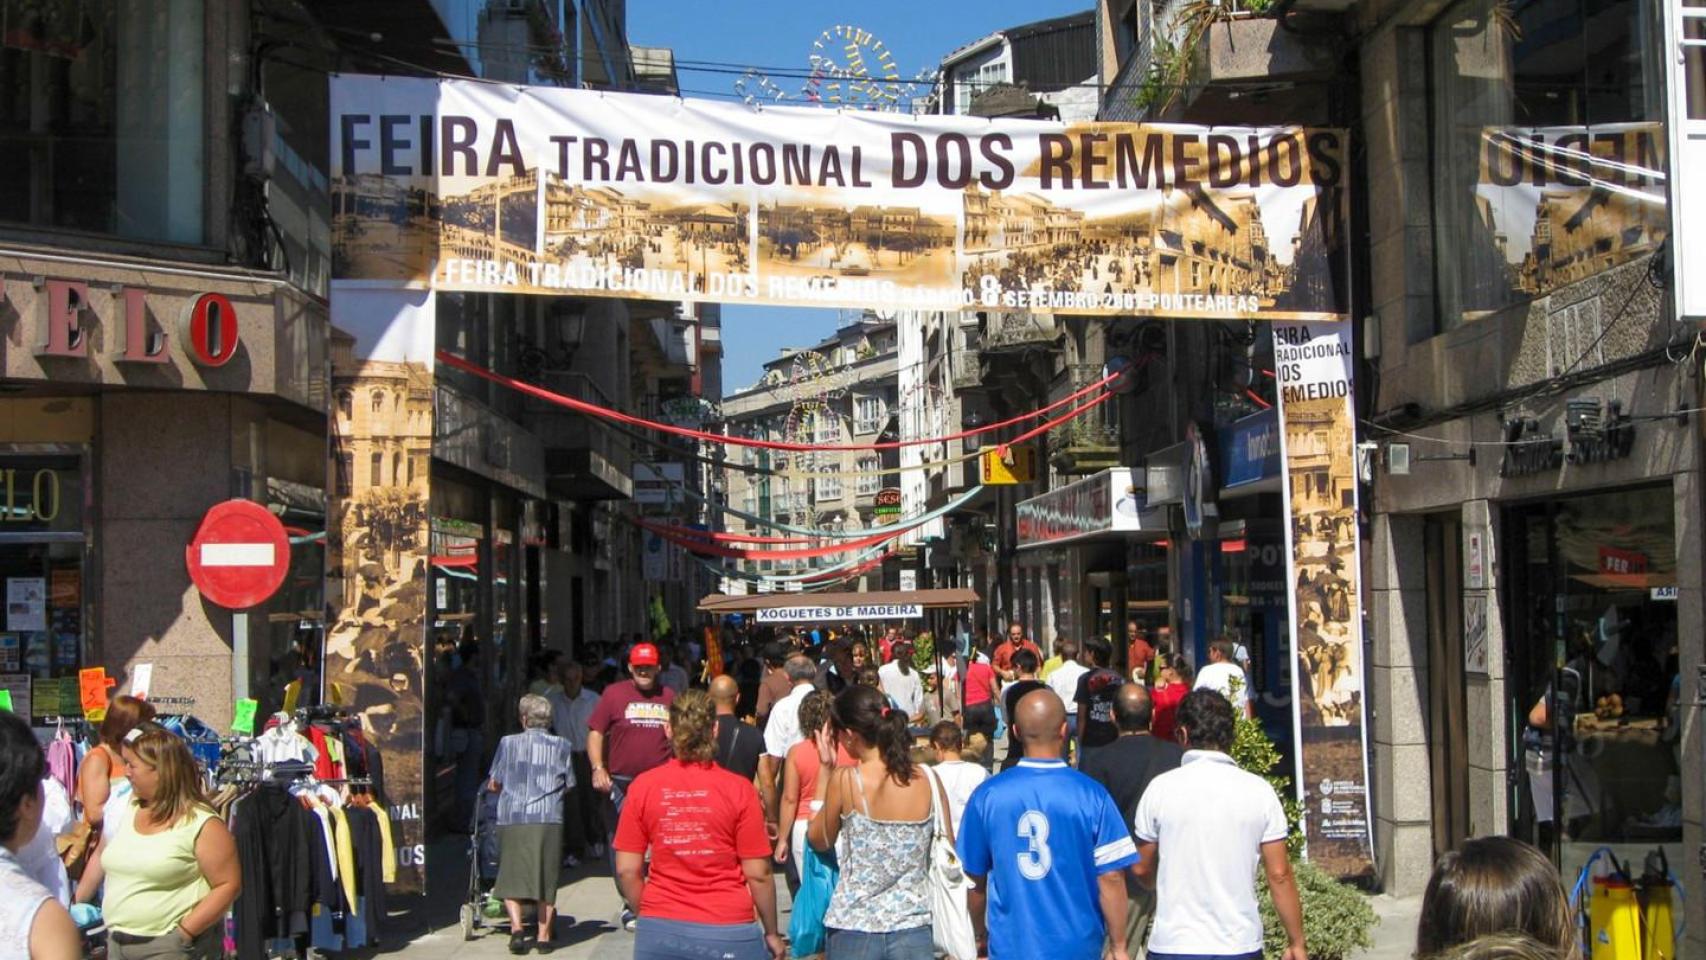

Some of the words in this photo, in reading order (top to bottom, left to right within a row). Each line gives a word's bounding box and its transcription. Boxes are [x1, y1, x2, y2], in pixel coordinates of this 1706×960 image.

[340, 113, 527, 177] FEIRA
[550, 135, 872, 188] TRADICIONAL
[891, 131, 1015, 190] DOS
[1039, 132, 1342, 191] REMEDIOS
[445, 258, 518, 286] FEIRA
[527, 260, 703, 295] TRADICIONAL
[709, 271, 759, 298] DOS
[980, 274, 1001, 307] 8
[0, 277, 239, 368] ELO
[1274, 325, 1312, 346] EIRA
[0, 467, 60, 522] LO
[760, 607, 833, 620] XOGUETES
[836, 606, 853, 618] DE
[857, 604, 918, 617] MADEIRA
[1016, 809, 1053, 881] 3
